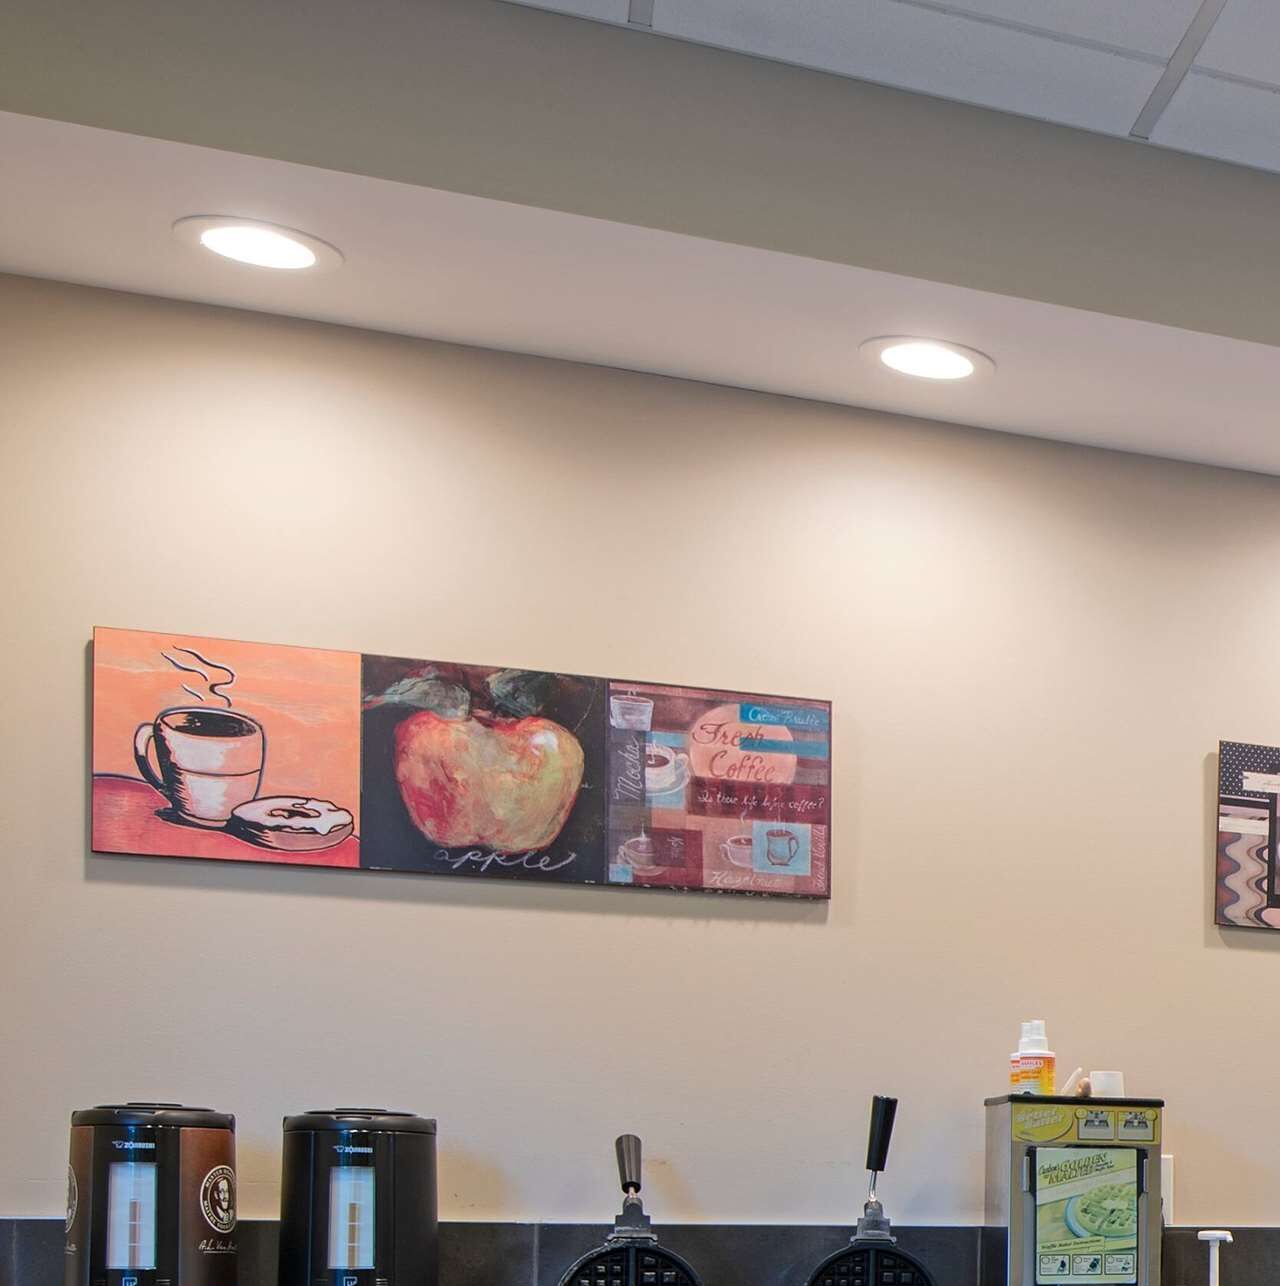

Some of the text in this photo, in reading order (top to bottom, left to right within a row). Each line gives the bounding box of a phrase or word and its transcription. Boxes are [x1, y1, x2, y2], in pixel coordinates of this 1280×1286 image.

[692, 722, 766, 748] Fresh
[613, 735, 641, 801] Mocha
[708, 749, 776, 783] Coffee
[788, 796, 826, 815] coffee?
[433, 848, 577, 871] apple
